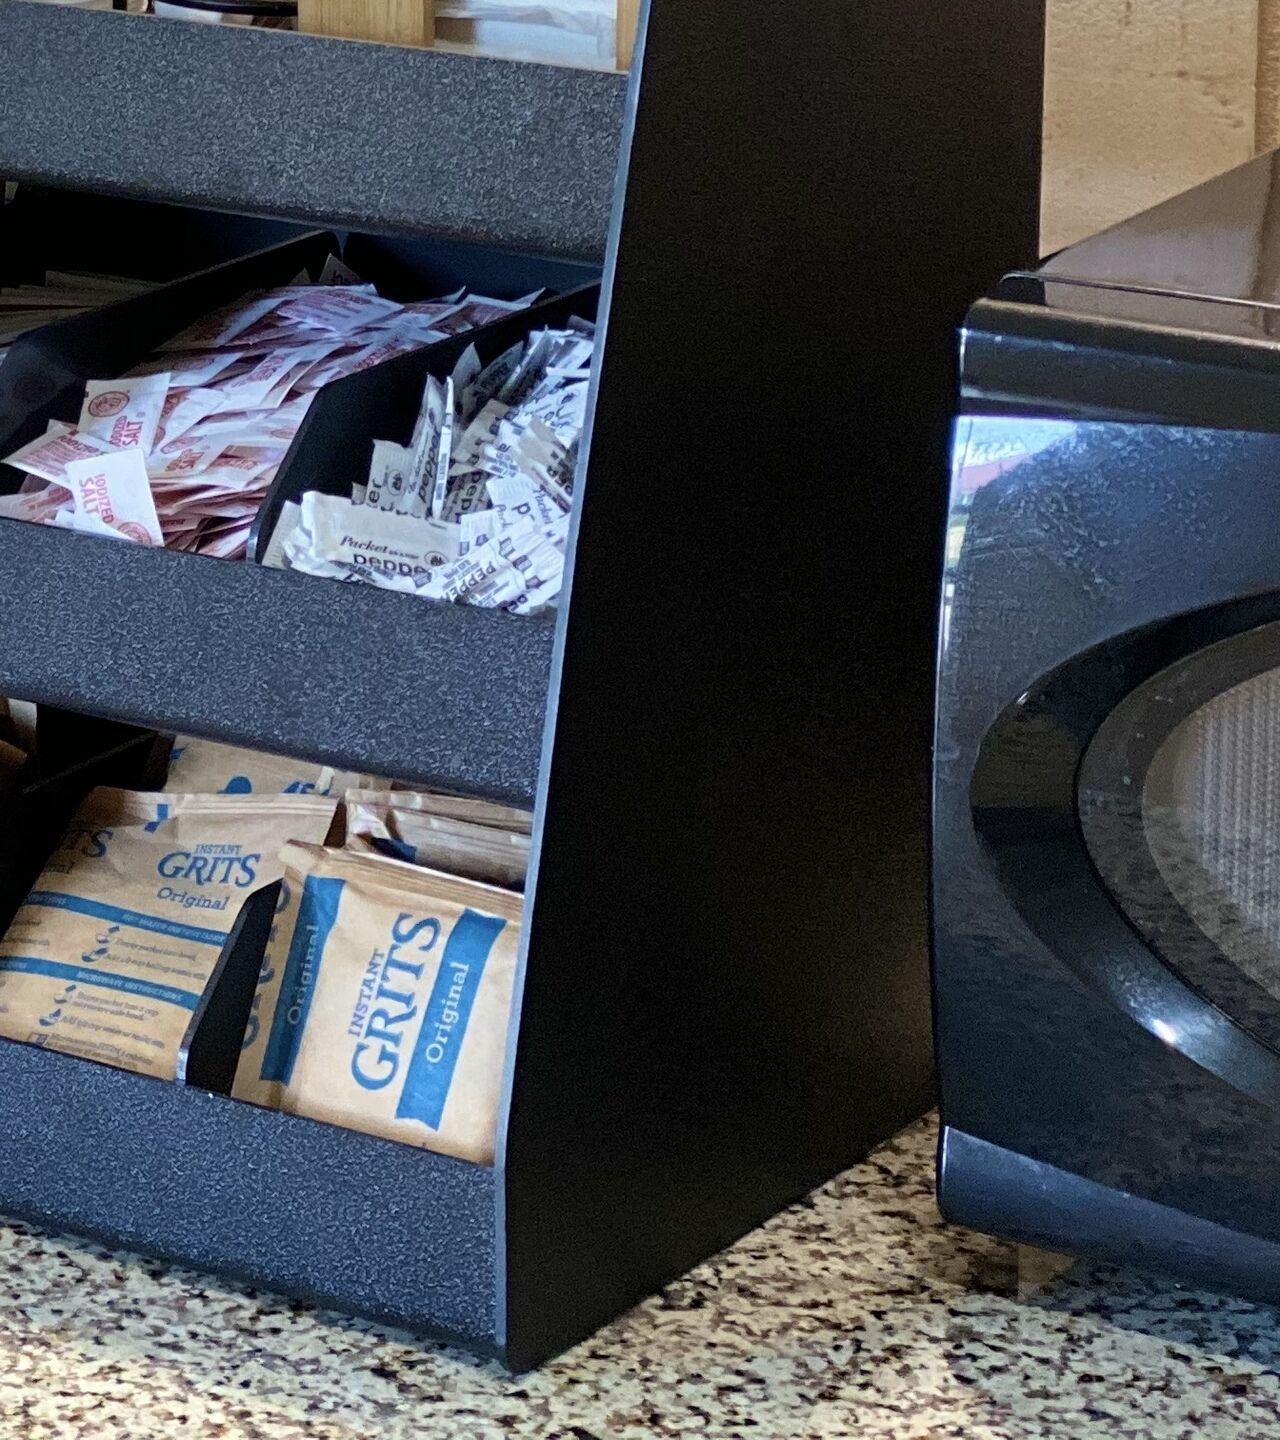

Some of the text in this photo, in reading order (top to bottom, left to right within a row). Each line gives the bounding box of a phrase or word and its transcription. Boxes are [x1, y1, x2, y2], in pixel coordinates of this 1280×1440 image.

[122, 420, 144, 449] SALT
[79, 477, 101, 514] SALT
[94, 473, 114, 524] IODIZED
[340, 534, 389, 555] Packet
[194, 844, 243, 855] INSTANT
[157, 852, 262, 888] GRITS
[156, 886, 230, 911] Original
[287, 924, 320, 1026] Original
[348, 948, 386, 1038] INSTANT
[351, 912, 442, 1092] GRITS
[425, 961, 471, 1065] Original
